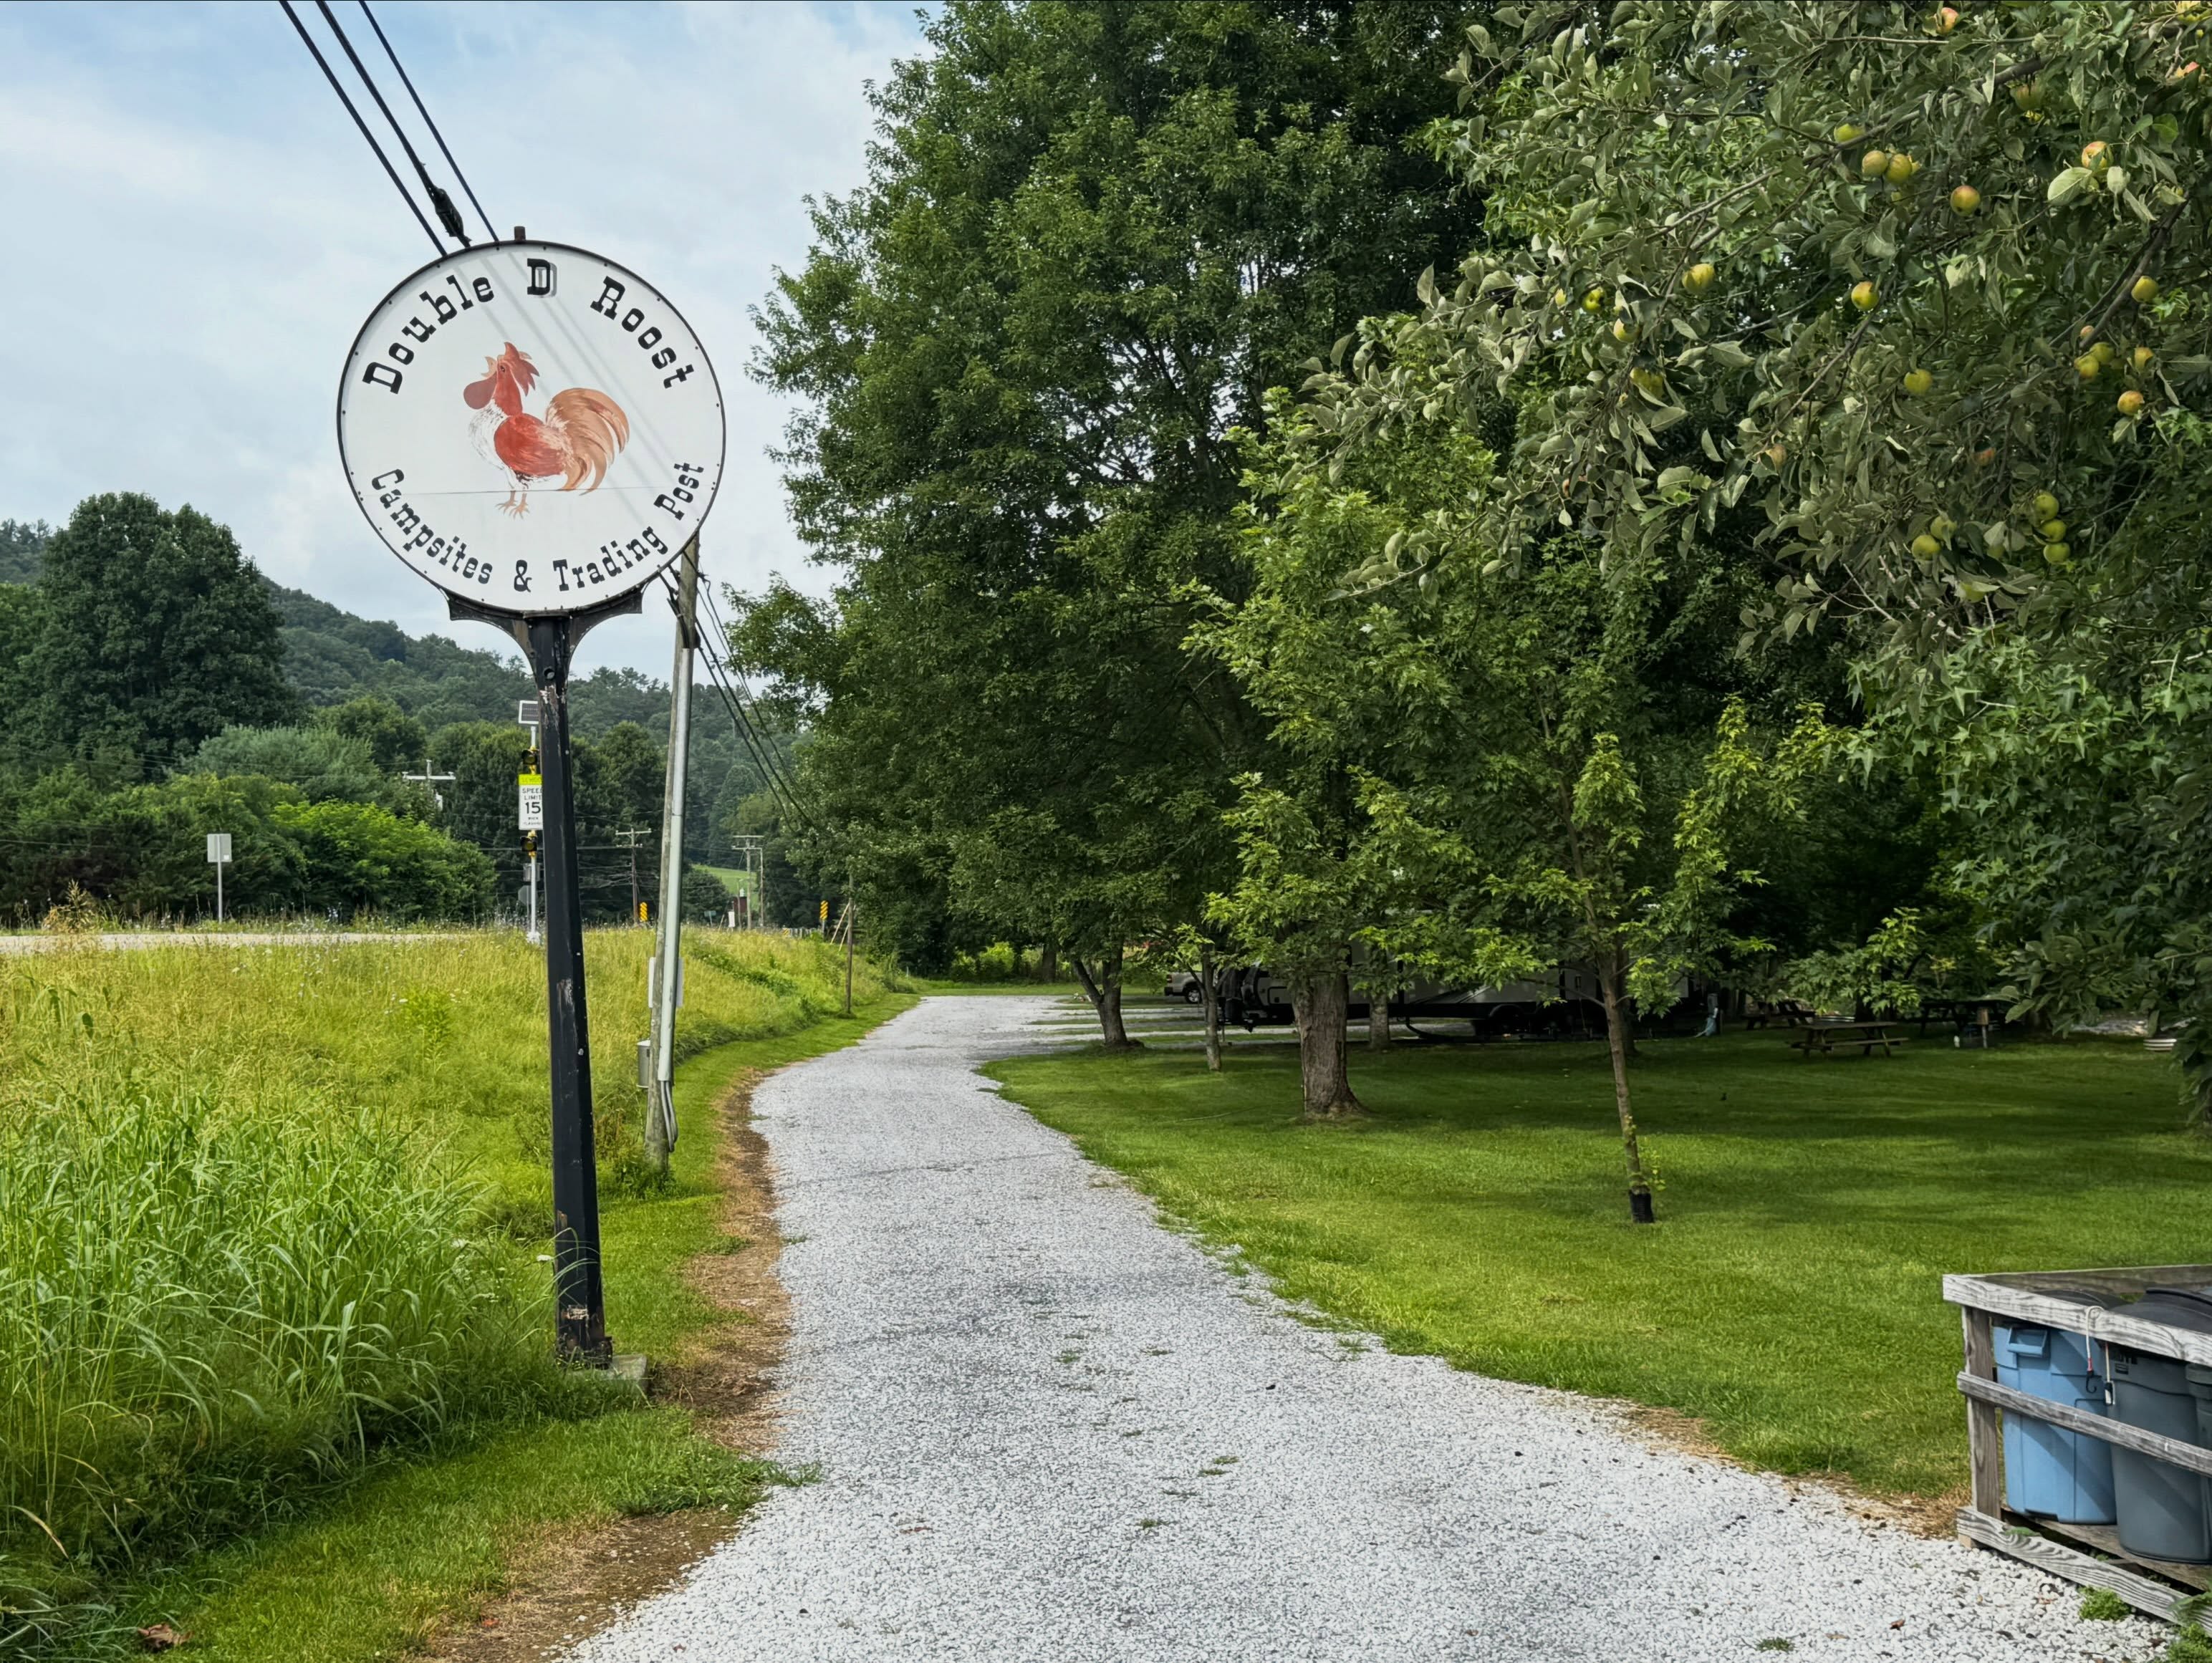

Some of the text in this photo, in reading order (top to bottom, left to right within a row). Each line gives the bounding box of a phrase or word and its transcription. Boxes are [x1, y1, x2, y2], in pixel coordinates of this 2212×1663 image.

[362, 258, 695, 395] Double D Roost
[371, 462, 704, 592] Campsites & Trading Post
[525, 801, 541, 814] 15
